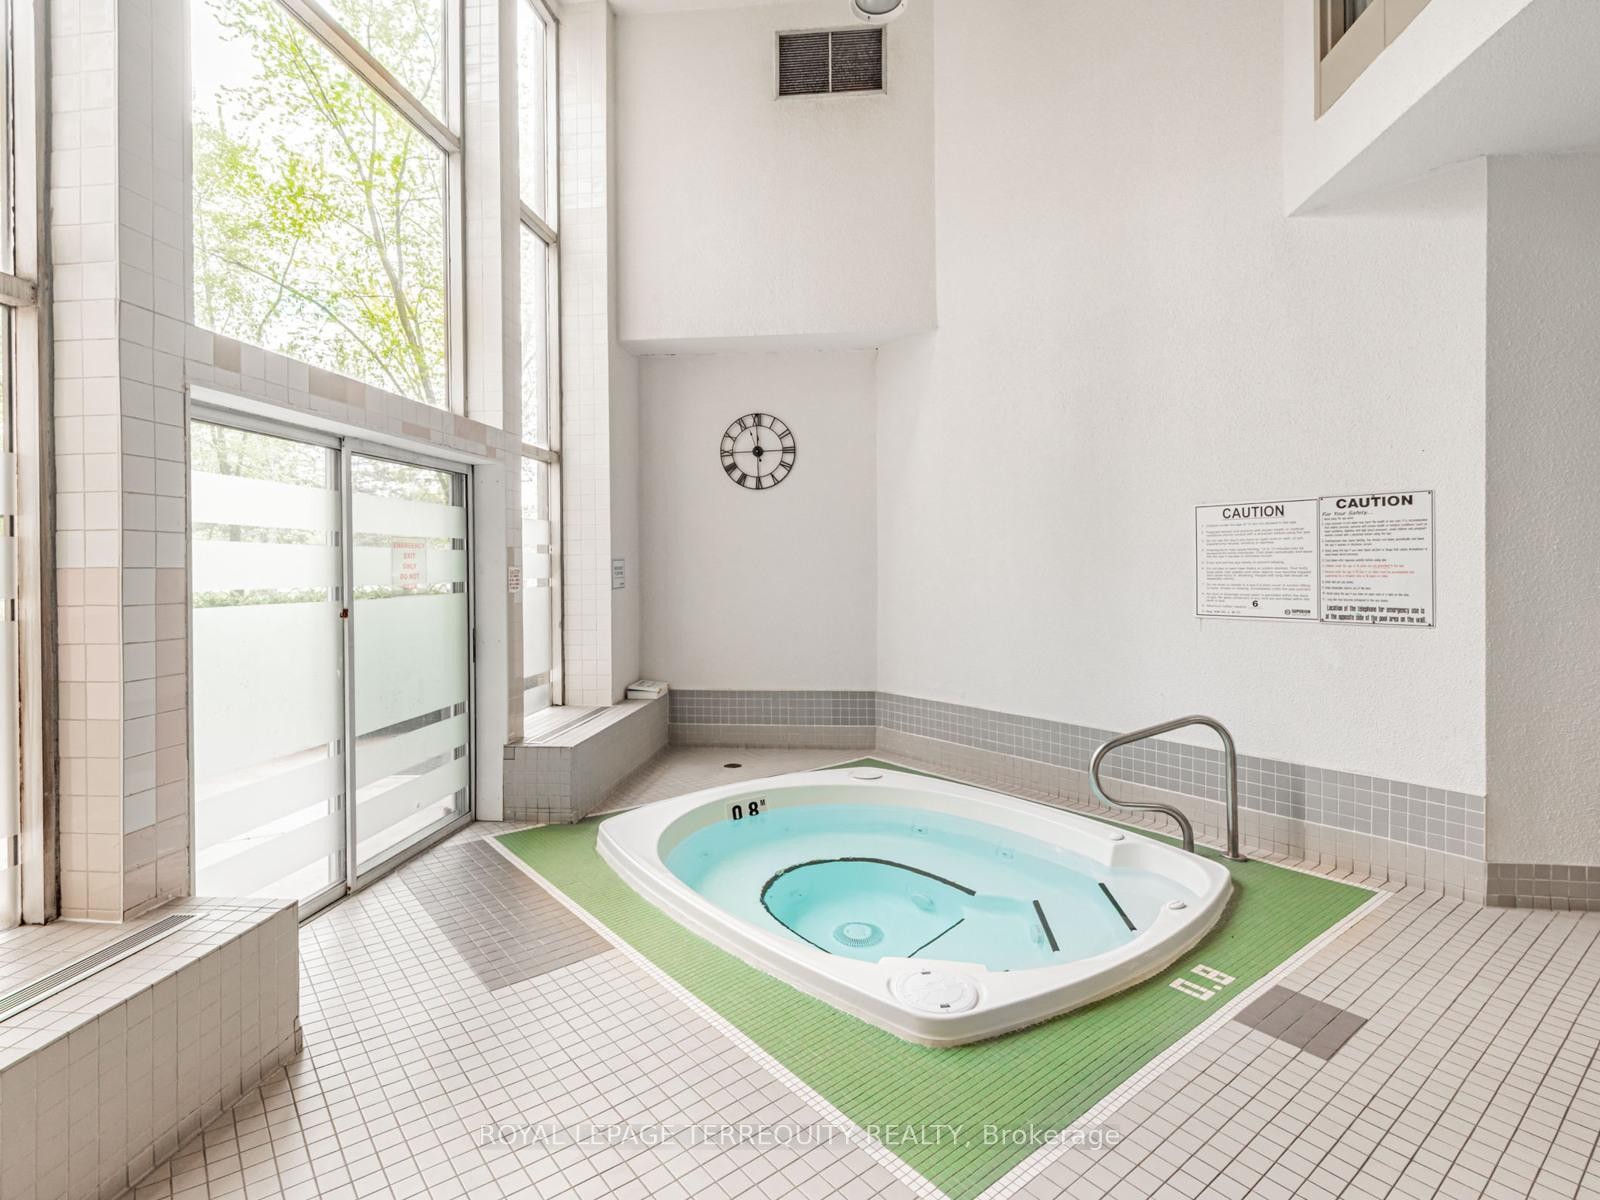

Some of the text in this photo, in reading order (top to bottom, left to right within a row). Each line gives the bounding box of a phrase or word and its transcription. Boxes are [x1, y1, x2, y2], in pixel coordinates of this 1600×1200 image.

[1336, 495, 1413, 509] CAUTION
[1222, 504, 1285, 519] CAUTION
[403, 552, 416, 560] EXIT
[1327, 604, 1343, 612] Location
[1386, 607, 1409, 615] emergency
[1338, 614, 1355, 622] opposite
